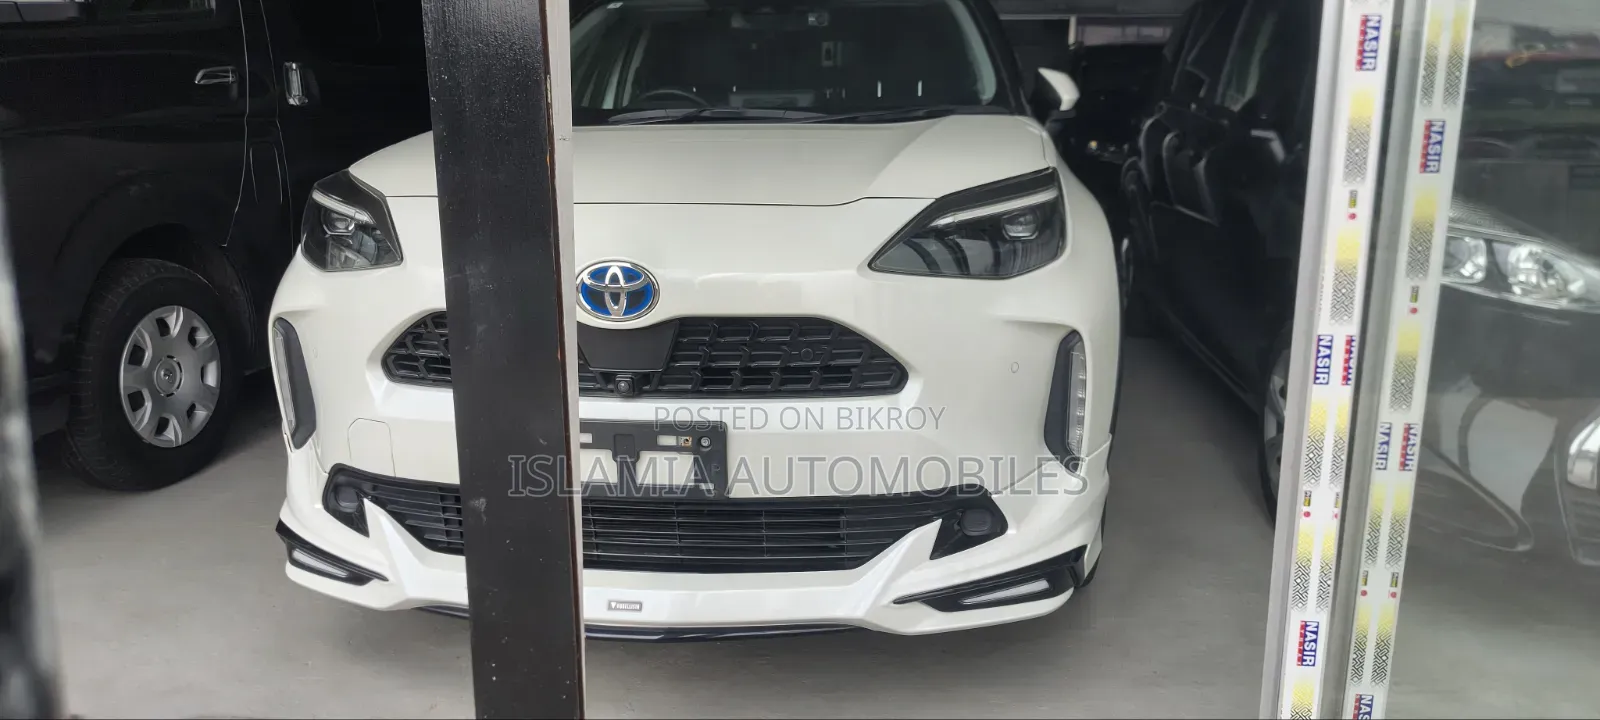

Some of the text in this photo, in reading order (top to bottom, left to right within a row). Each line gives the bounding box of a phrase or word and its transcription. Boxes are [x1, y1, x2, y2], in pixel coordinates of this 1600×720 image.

[1362, 15, 1381, 70] NASIR
[1424, 121, 1445, 173] NASIR
[1314, 335, 1332, 384] NASIR
[1375, 423, 1392, 470] NASIR
[1302, 621, 1319, 666] NASIR
